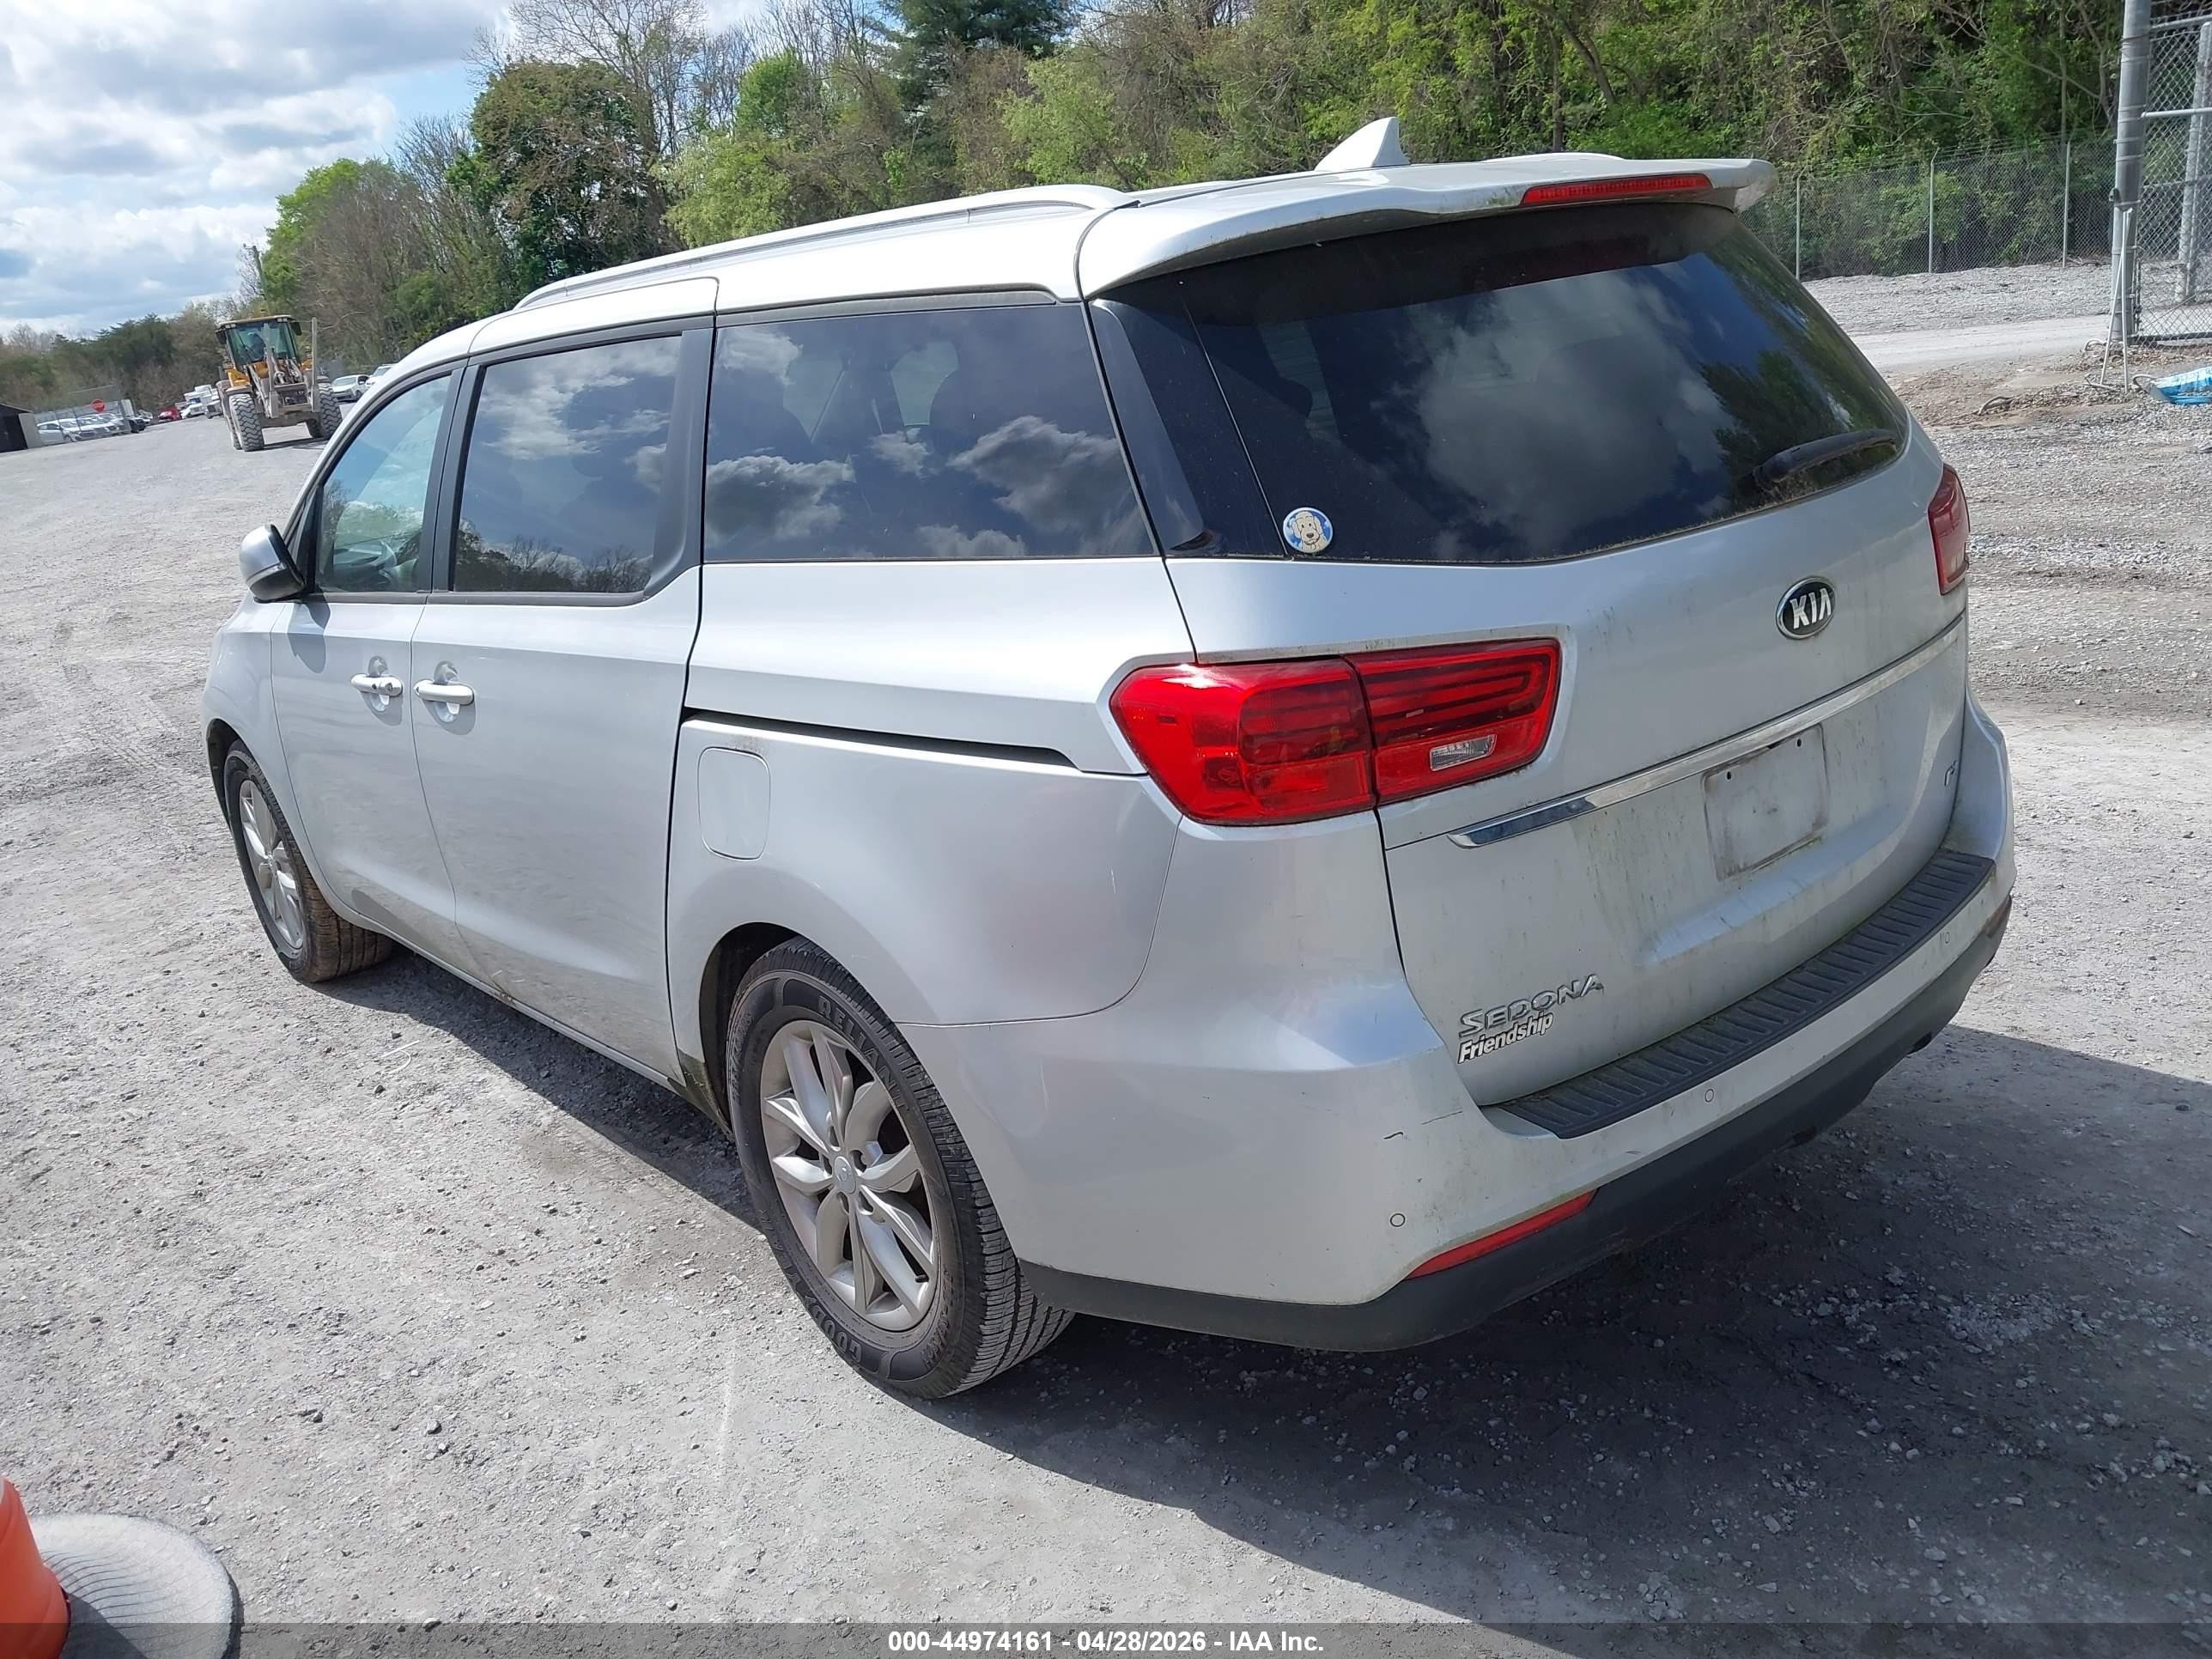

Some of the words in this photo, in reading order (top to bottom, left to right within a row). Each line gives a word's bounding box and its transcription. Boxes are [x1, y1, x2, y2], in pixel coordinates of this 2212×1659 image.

[1790, 587, 1832, 629] KIA
[1459, 974, 1605, 1038] SEDONA
[1457, 1012, 1554, 1064] Friendship
